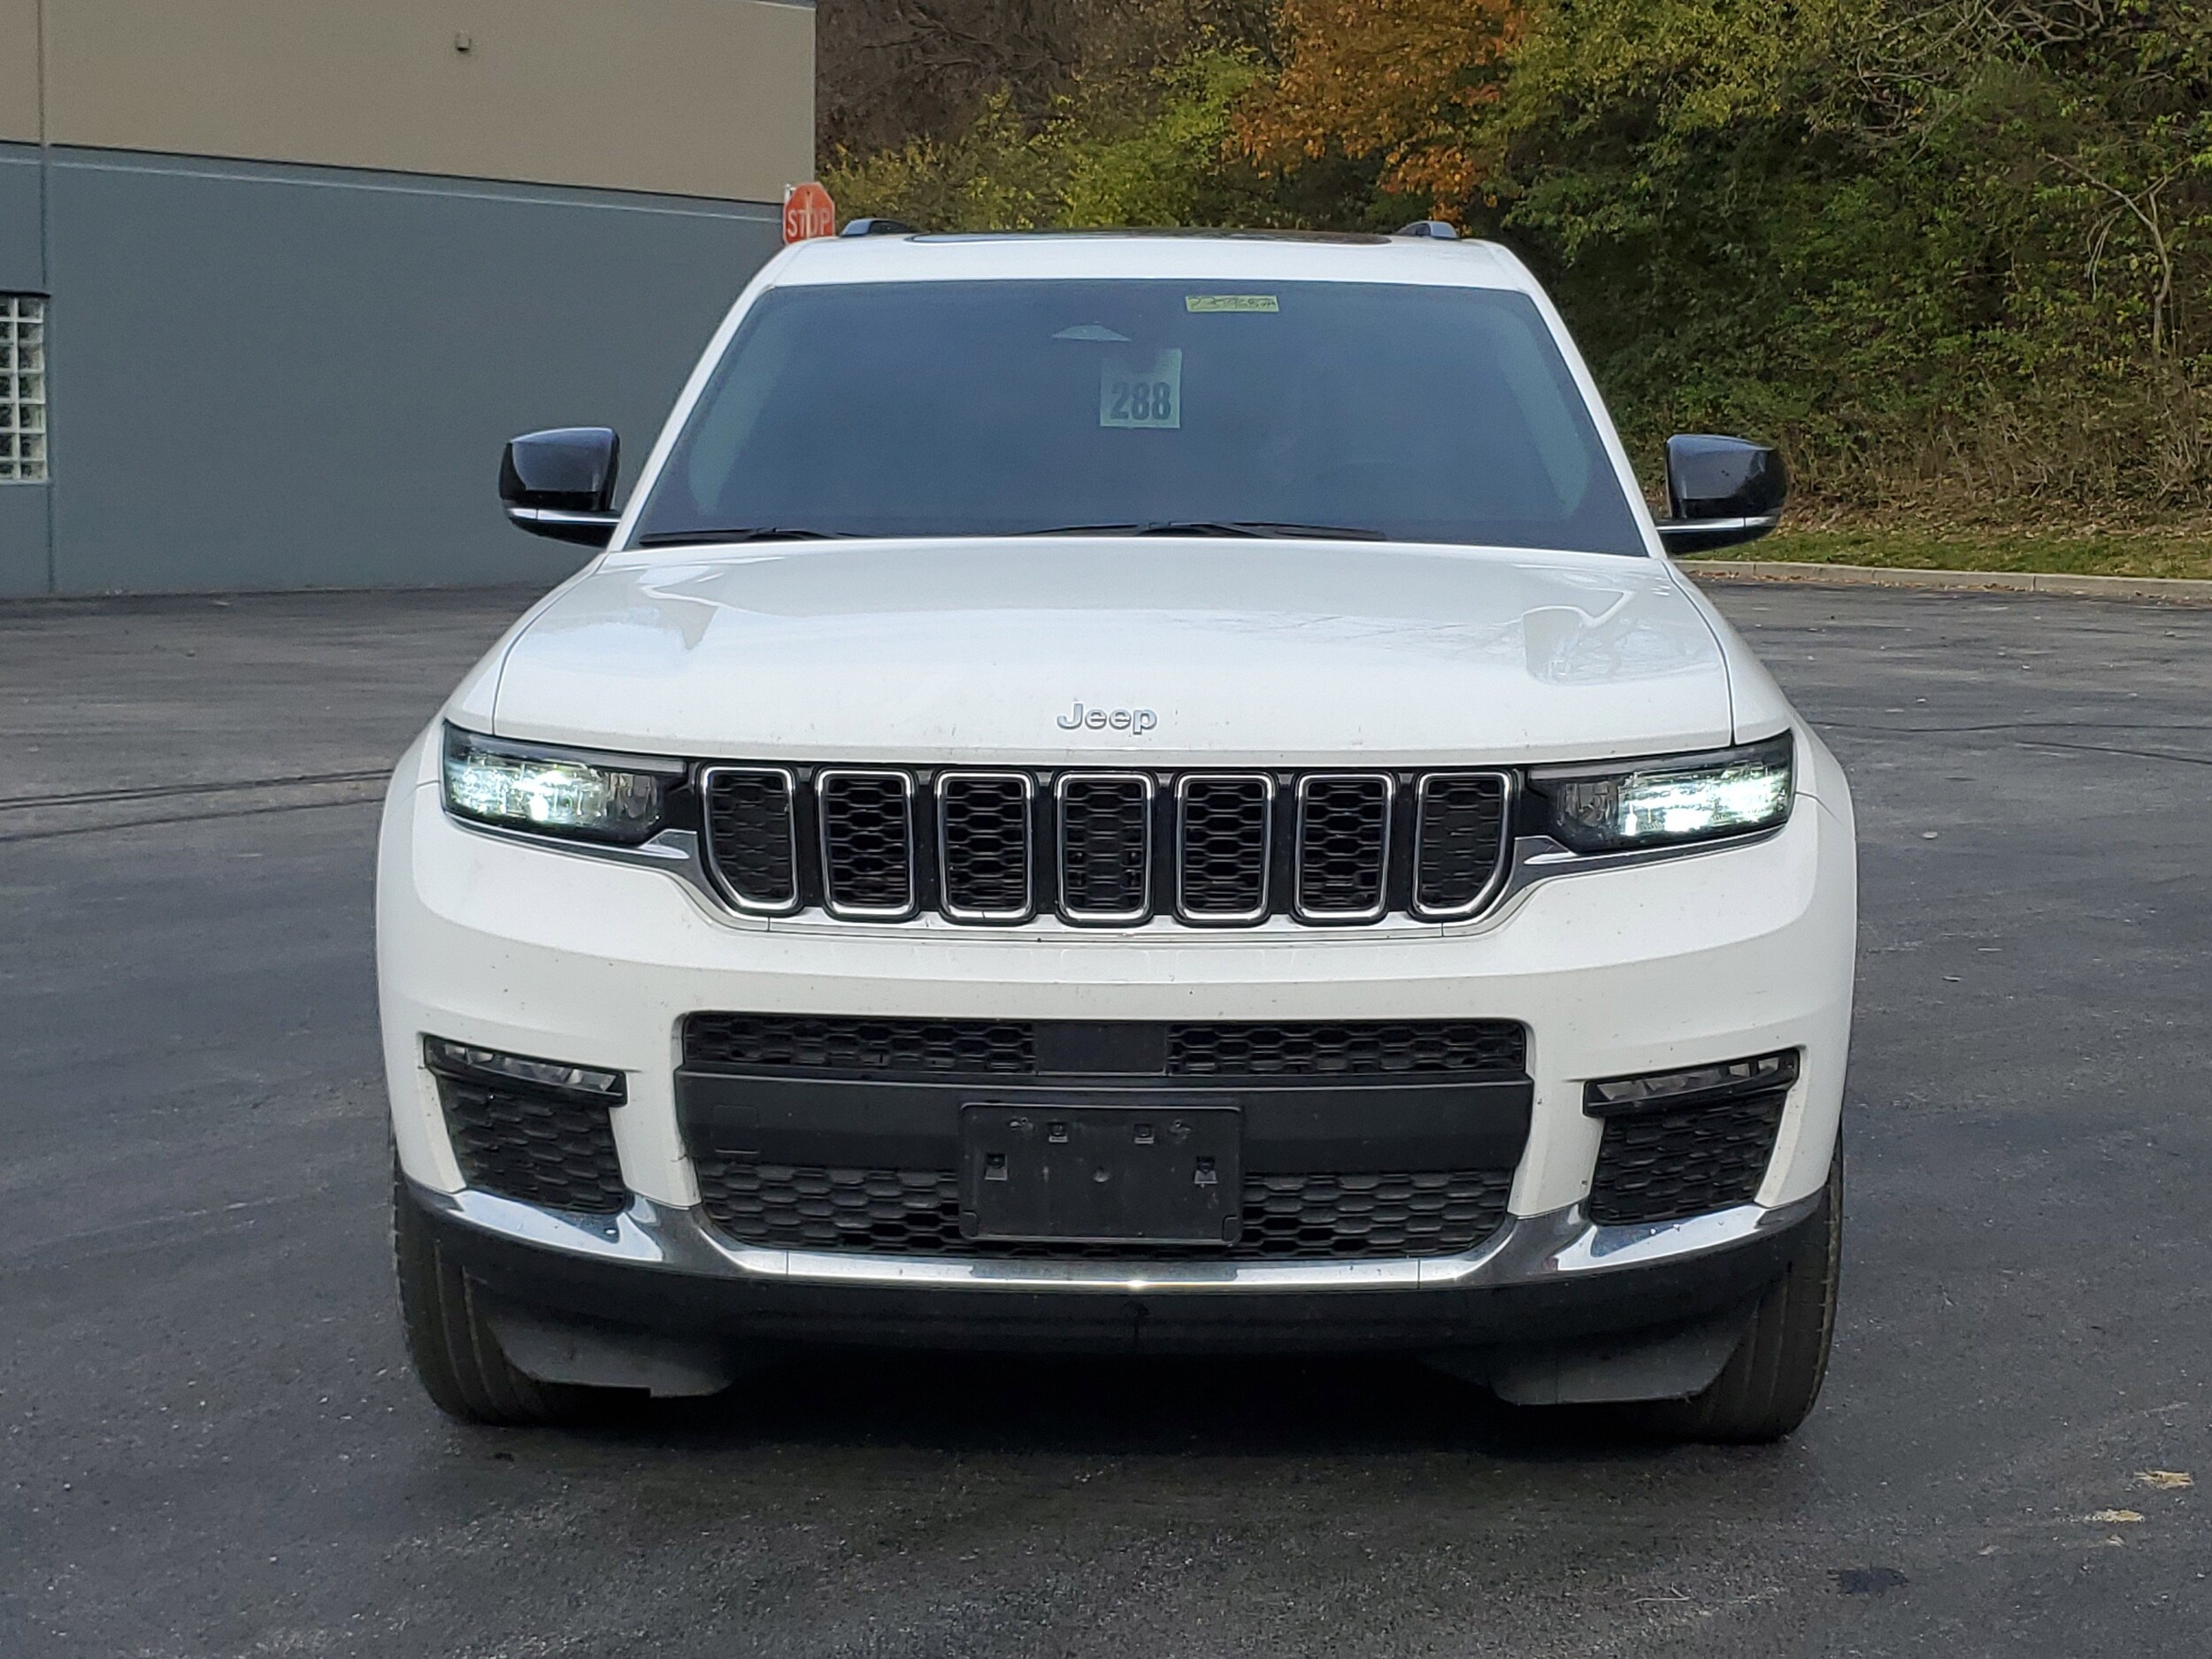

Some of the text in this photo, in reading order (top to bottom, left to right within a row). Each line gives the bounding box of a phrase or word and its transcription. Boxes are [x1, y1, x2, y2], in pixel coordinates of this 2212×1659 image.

[787, 209, 830, 237] STOP
[1110, 381, 1171, 420] 288
[1057, 703, 1157, 734] Jeep
